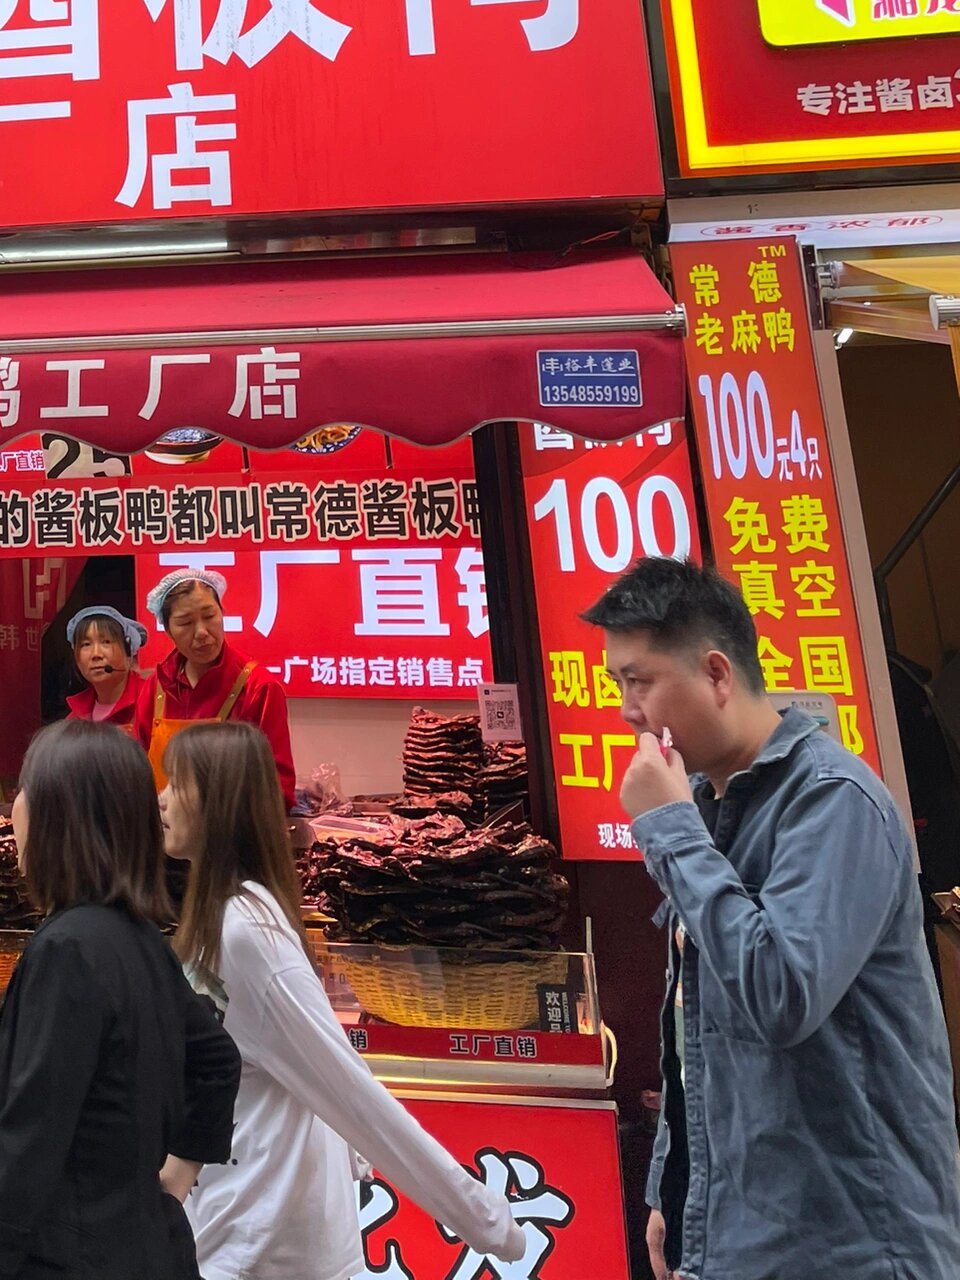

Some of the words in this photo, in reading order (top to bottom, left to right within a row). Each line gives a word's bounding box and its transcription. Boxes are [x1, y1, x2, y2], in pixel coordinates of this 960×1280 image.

[797, 70, 960, 117] 专注酱卤
[758, 245, 787, 258] TM
[689, 261, 782, 307] 常德
[695, 308, 795, 355] 老麻鸭
[544, 385, 639, 402] 13548559199
[534, 475, 692, 573] 100
[723, 494, 830, 555] 免费
[732, 559, 841, 620] 真空
[559, 733, 636, 792] 工厂
[598, 822, 638, 849] 现场
[450, 1034, 537, 1058] 工厂直销
